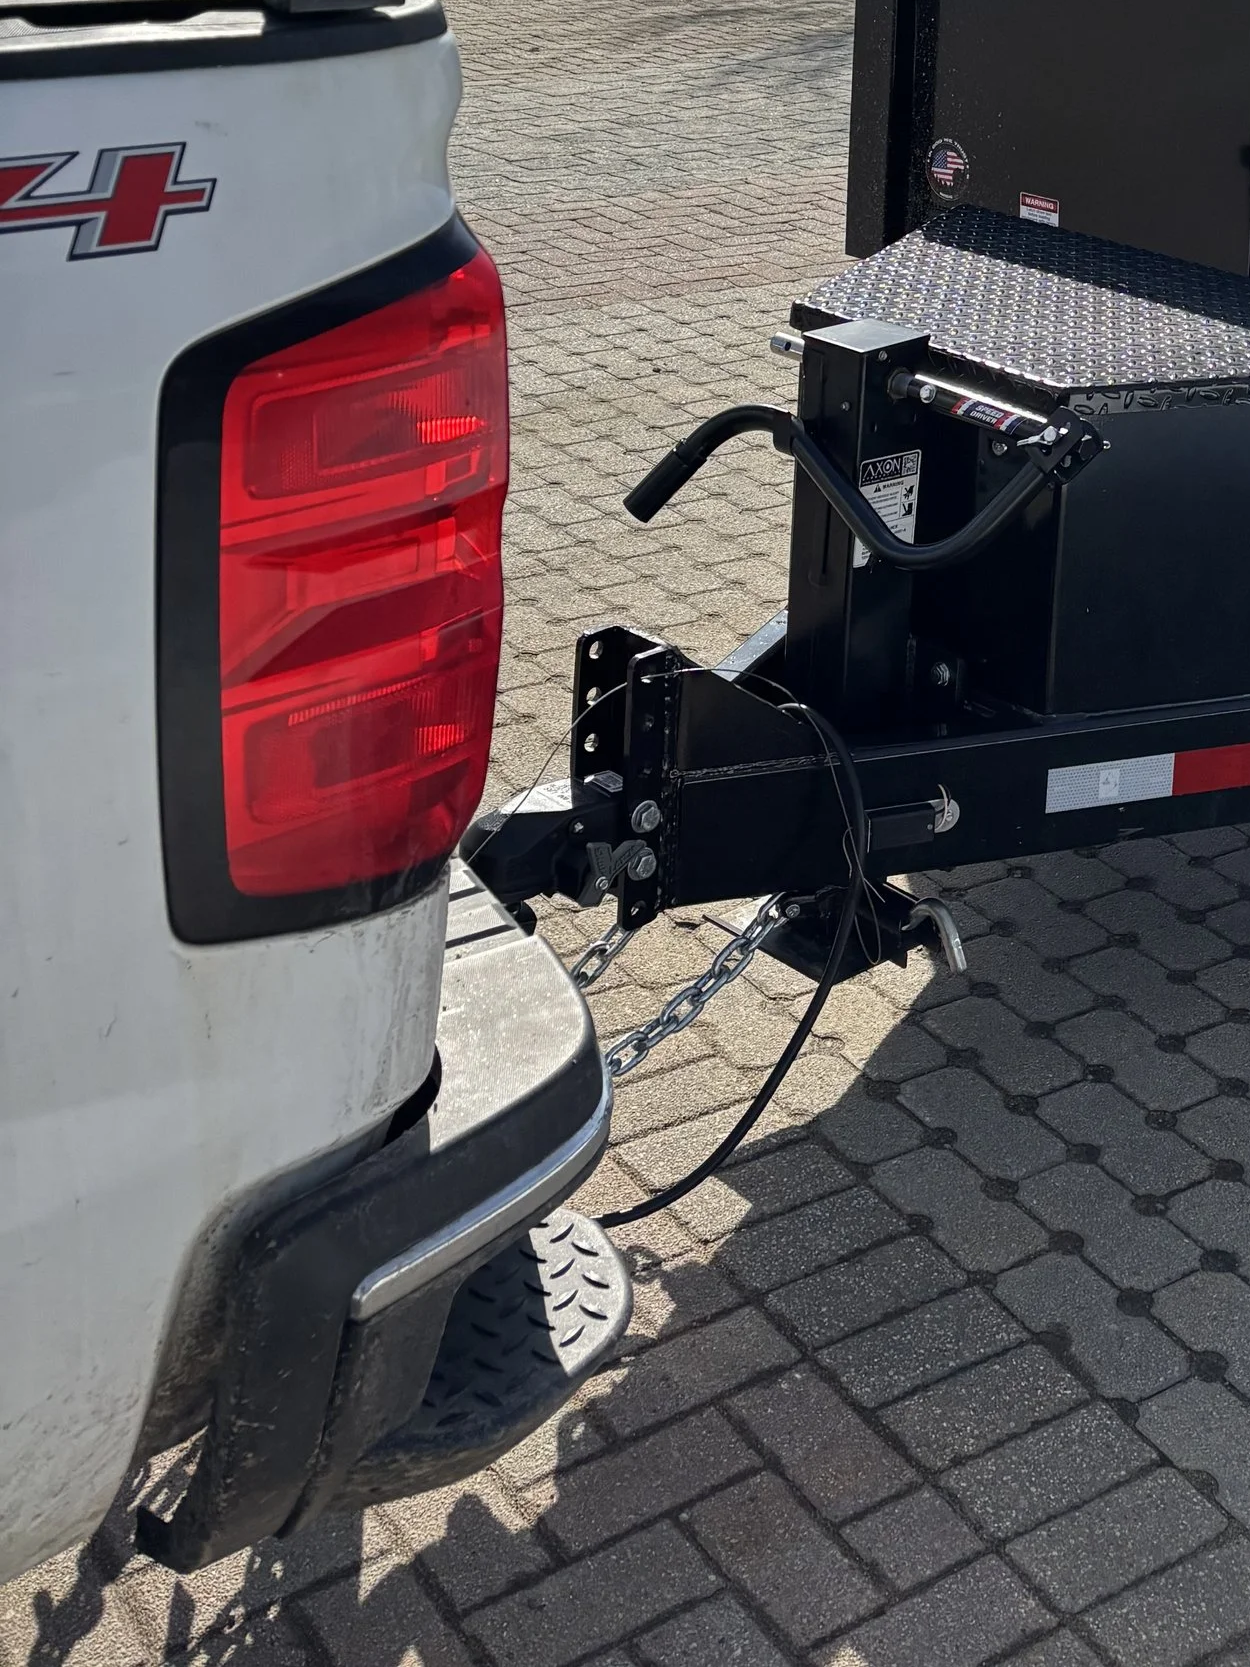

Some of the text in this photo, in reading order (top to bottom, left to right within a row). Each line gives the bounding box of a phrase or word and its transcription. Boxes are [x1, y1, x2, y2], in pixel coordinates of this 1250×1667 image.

[1025, 197, 1054, 210] WARNING
[969, 410, 998, 424] DRIVER
[975, 405, 1004, 418] SPEED
[863, 457, 901, 480] AXON
[882, 480, 905, 490] WARNING
